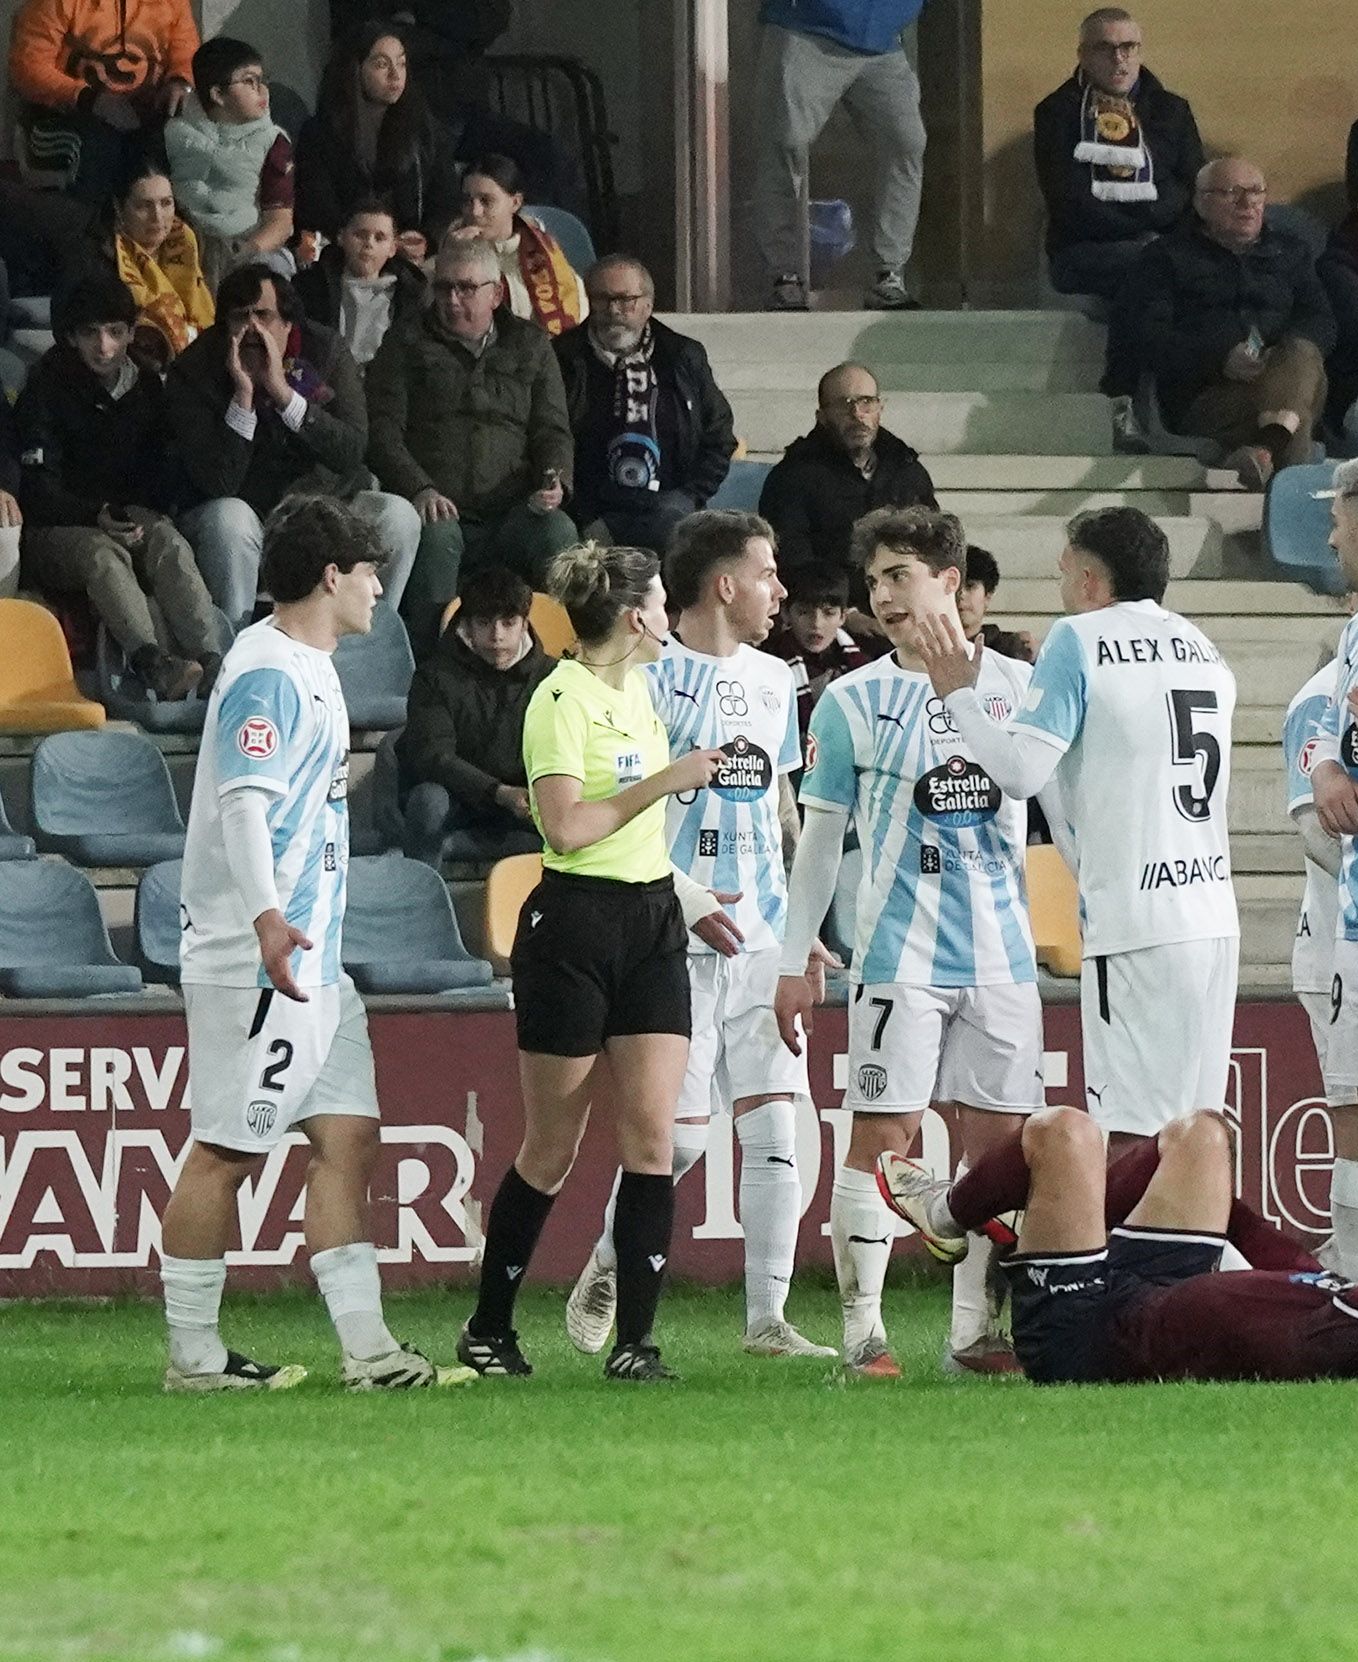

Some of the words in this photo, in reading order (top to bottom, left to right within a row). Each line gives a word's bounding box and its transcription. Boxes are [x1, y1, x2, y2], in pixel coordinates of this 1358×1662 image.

[1097, 636, 1165, 666] ÁLEX
[617, 754, 642, 769] FIFA
[1166, 689, 1220, 823] 5
[718, 769, 763, 787] Galicia
[928, 775, 991, 795] Estrella
[931, 793, 990, 812] Galicia
[721, 844, 736, 855] DE
[722, 832, 758, 842] XUNTA
[1330, 972, 1343, 1026] 9
[868, 997, 894, 1054] 7
[258, 1038, 294, 1095] 2
[0, 1047, 192, 1112] SERV
